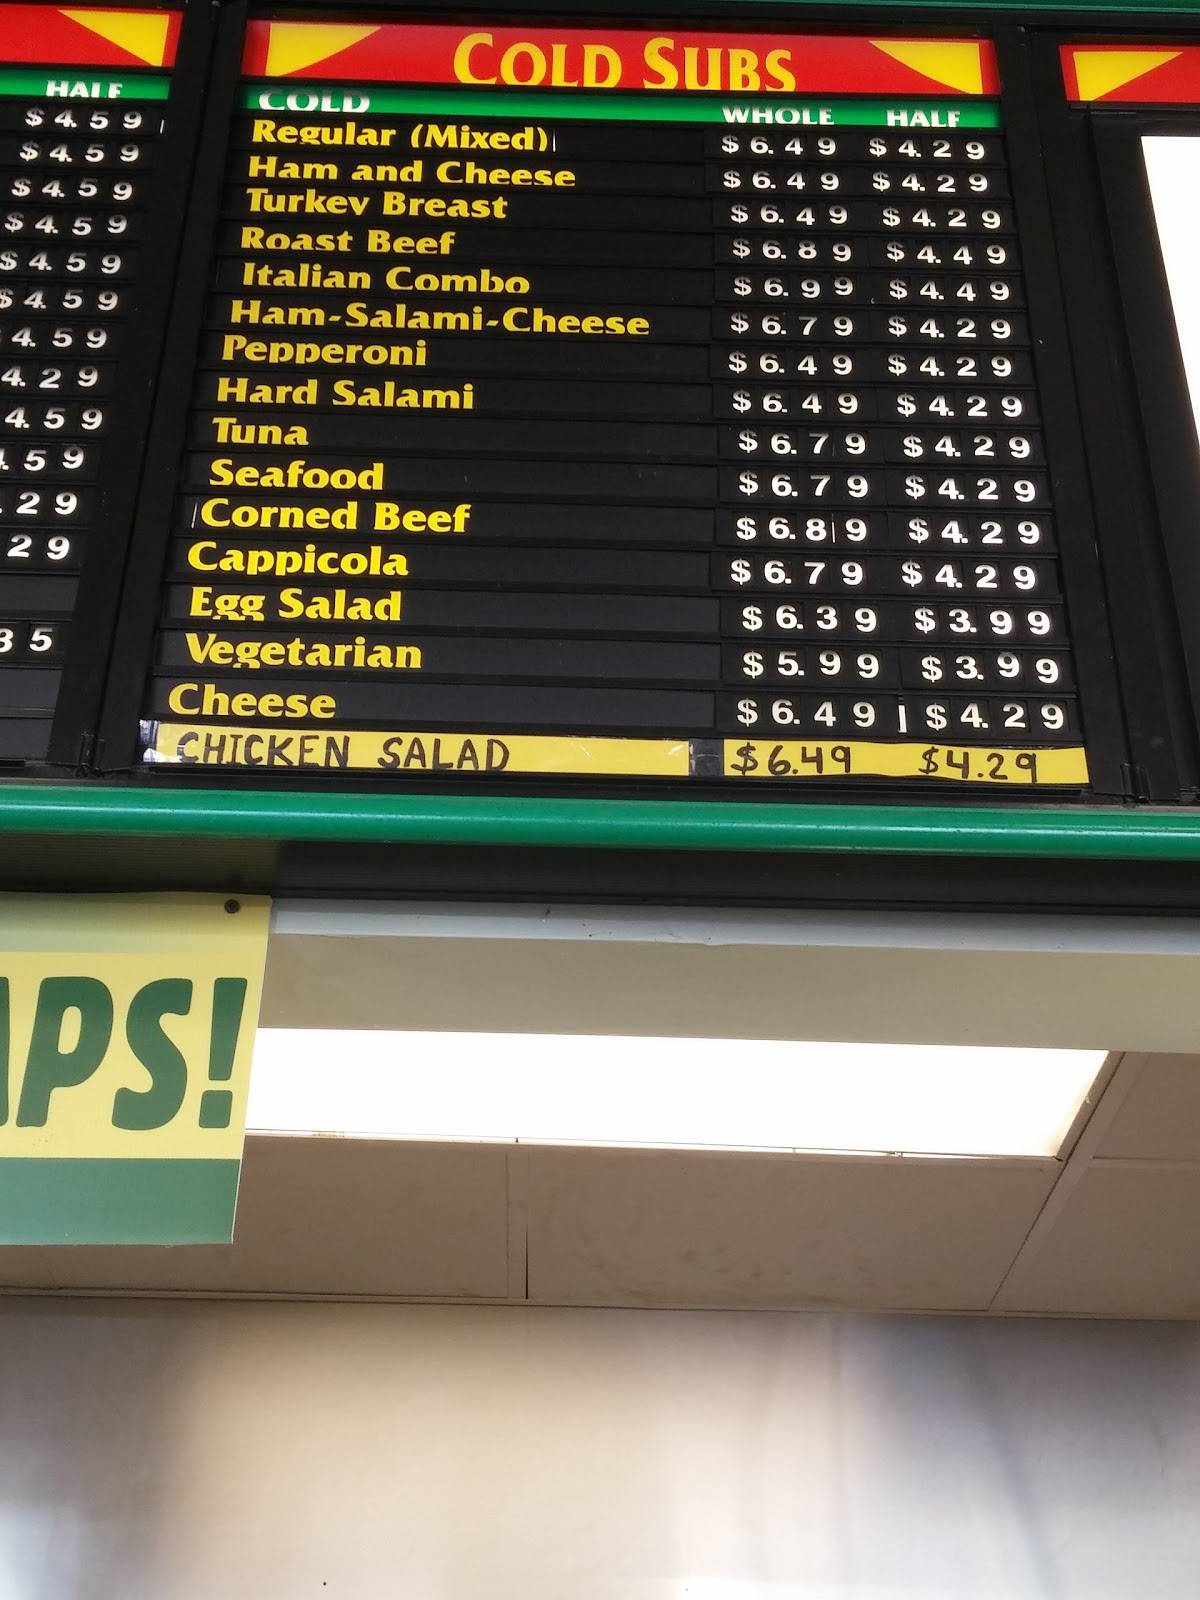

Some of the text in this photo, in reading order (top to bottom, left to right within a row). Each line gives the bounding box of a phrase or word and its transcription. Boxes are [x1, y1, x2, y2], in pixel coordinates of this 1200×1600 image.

[454, 33, 796, 91] COLD SUBS
[46, 81, 122, 98] HALF
[259, 94, 369, 113] COLD
[25, 111, 142, 129] $4.59
[723, 108, 960, 127] WHOLE HALF
[252, 120, 547, 151] Regular (Mixed)
[722, 137, 836, 155] $6.49
[20, 146, 138, 162] $4.59
[870, 139, 984, 159] $4.29
[249, 156, 575, 186] Ham and Cheese
[724, 172, 839, 190] $6.49
[873, 172, 987, 192] $4.29
[12, 181, 132, 200] $4.59
[383, 192, 507, 218] Breast
[731, 206, 847, 225] $6.49
[5, 216, 126, 235] $4.59
[883, 209, 1000, 229] $4.29
[241, 227, 455, 254] Roast Beef
[733, 242, 851, 261] $6.89
[0, 253, 121, 274] $4.59
[887, 246, 1006, 265] $4.49
[243, 263, 529, 293] Italian Combo
[734, 279, 853, 298] $6.99
[890, 281, 1009, 301] $4.49
[231, 300, 649, 334] Ham-Salami-Cheese
[731, 316, 853, 336] $6.79
[889, 318, 1011, 338] $4.29
[222, 335, 426, 365] Pepperoni
[729, 353, 852, 375] $6.49
[888, 355, 1011, 377] $4.29
[1, 369, 98, 388] 4.29
[218, 378, 473, 409] Hard Salami
[733, 393, 858, 414] $6.49
[897, 394, 1022, 417] $4.29
[5, 408, 102, 430] 4.59
[213, 417, 309, 445] Tuna
[739, 433, 865, 454] $6.79
[904, 436, 1030, 458] $4.29
[210, 459, 383, 490] Seafood
[739, 473, 868, 497] $6.79
[906, 476, 1035, 502] $4.29
[201, 498, 471, 532] Corned Beef
[737, 517, 866, 541] $6.89
[909, 518, 1040, 544] $4.29
[7, 535, 70, 560] 29
[188, 541, 409, 576] Cappicola
[731, 559, 863, 585] $6.79
[902, 561, 1036, 590] $4.29
[190, 587, 401, 621] Egg Salad
[742, 605, 876, 632] $6.39
[915, 607, 1050, 635] $3.99
[185, 633, 421, 668] Vegetarian
[743, 651, 879, 679] $5.99
[922, 653, 1058, 683] $3.99
[169, 683, 336, 718] Cheese
[737, 699, 875, 727] $6.49
[926, 703, 1063, 730] $4.29
[178, 732, 510, 772] CHICKEN SALAD
[730, 743, 852, 775] $6.49
[918, 746, 1038, 783] $4.29
